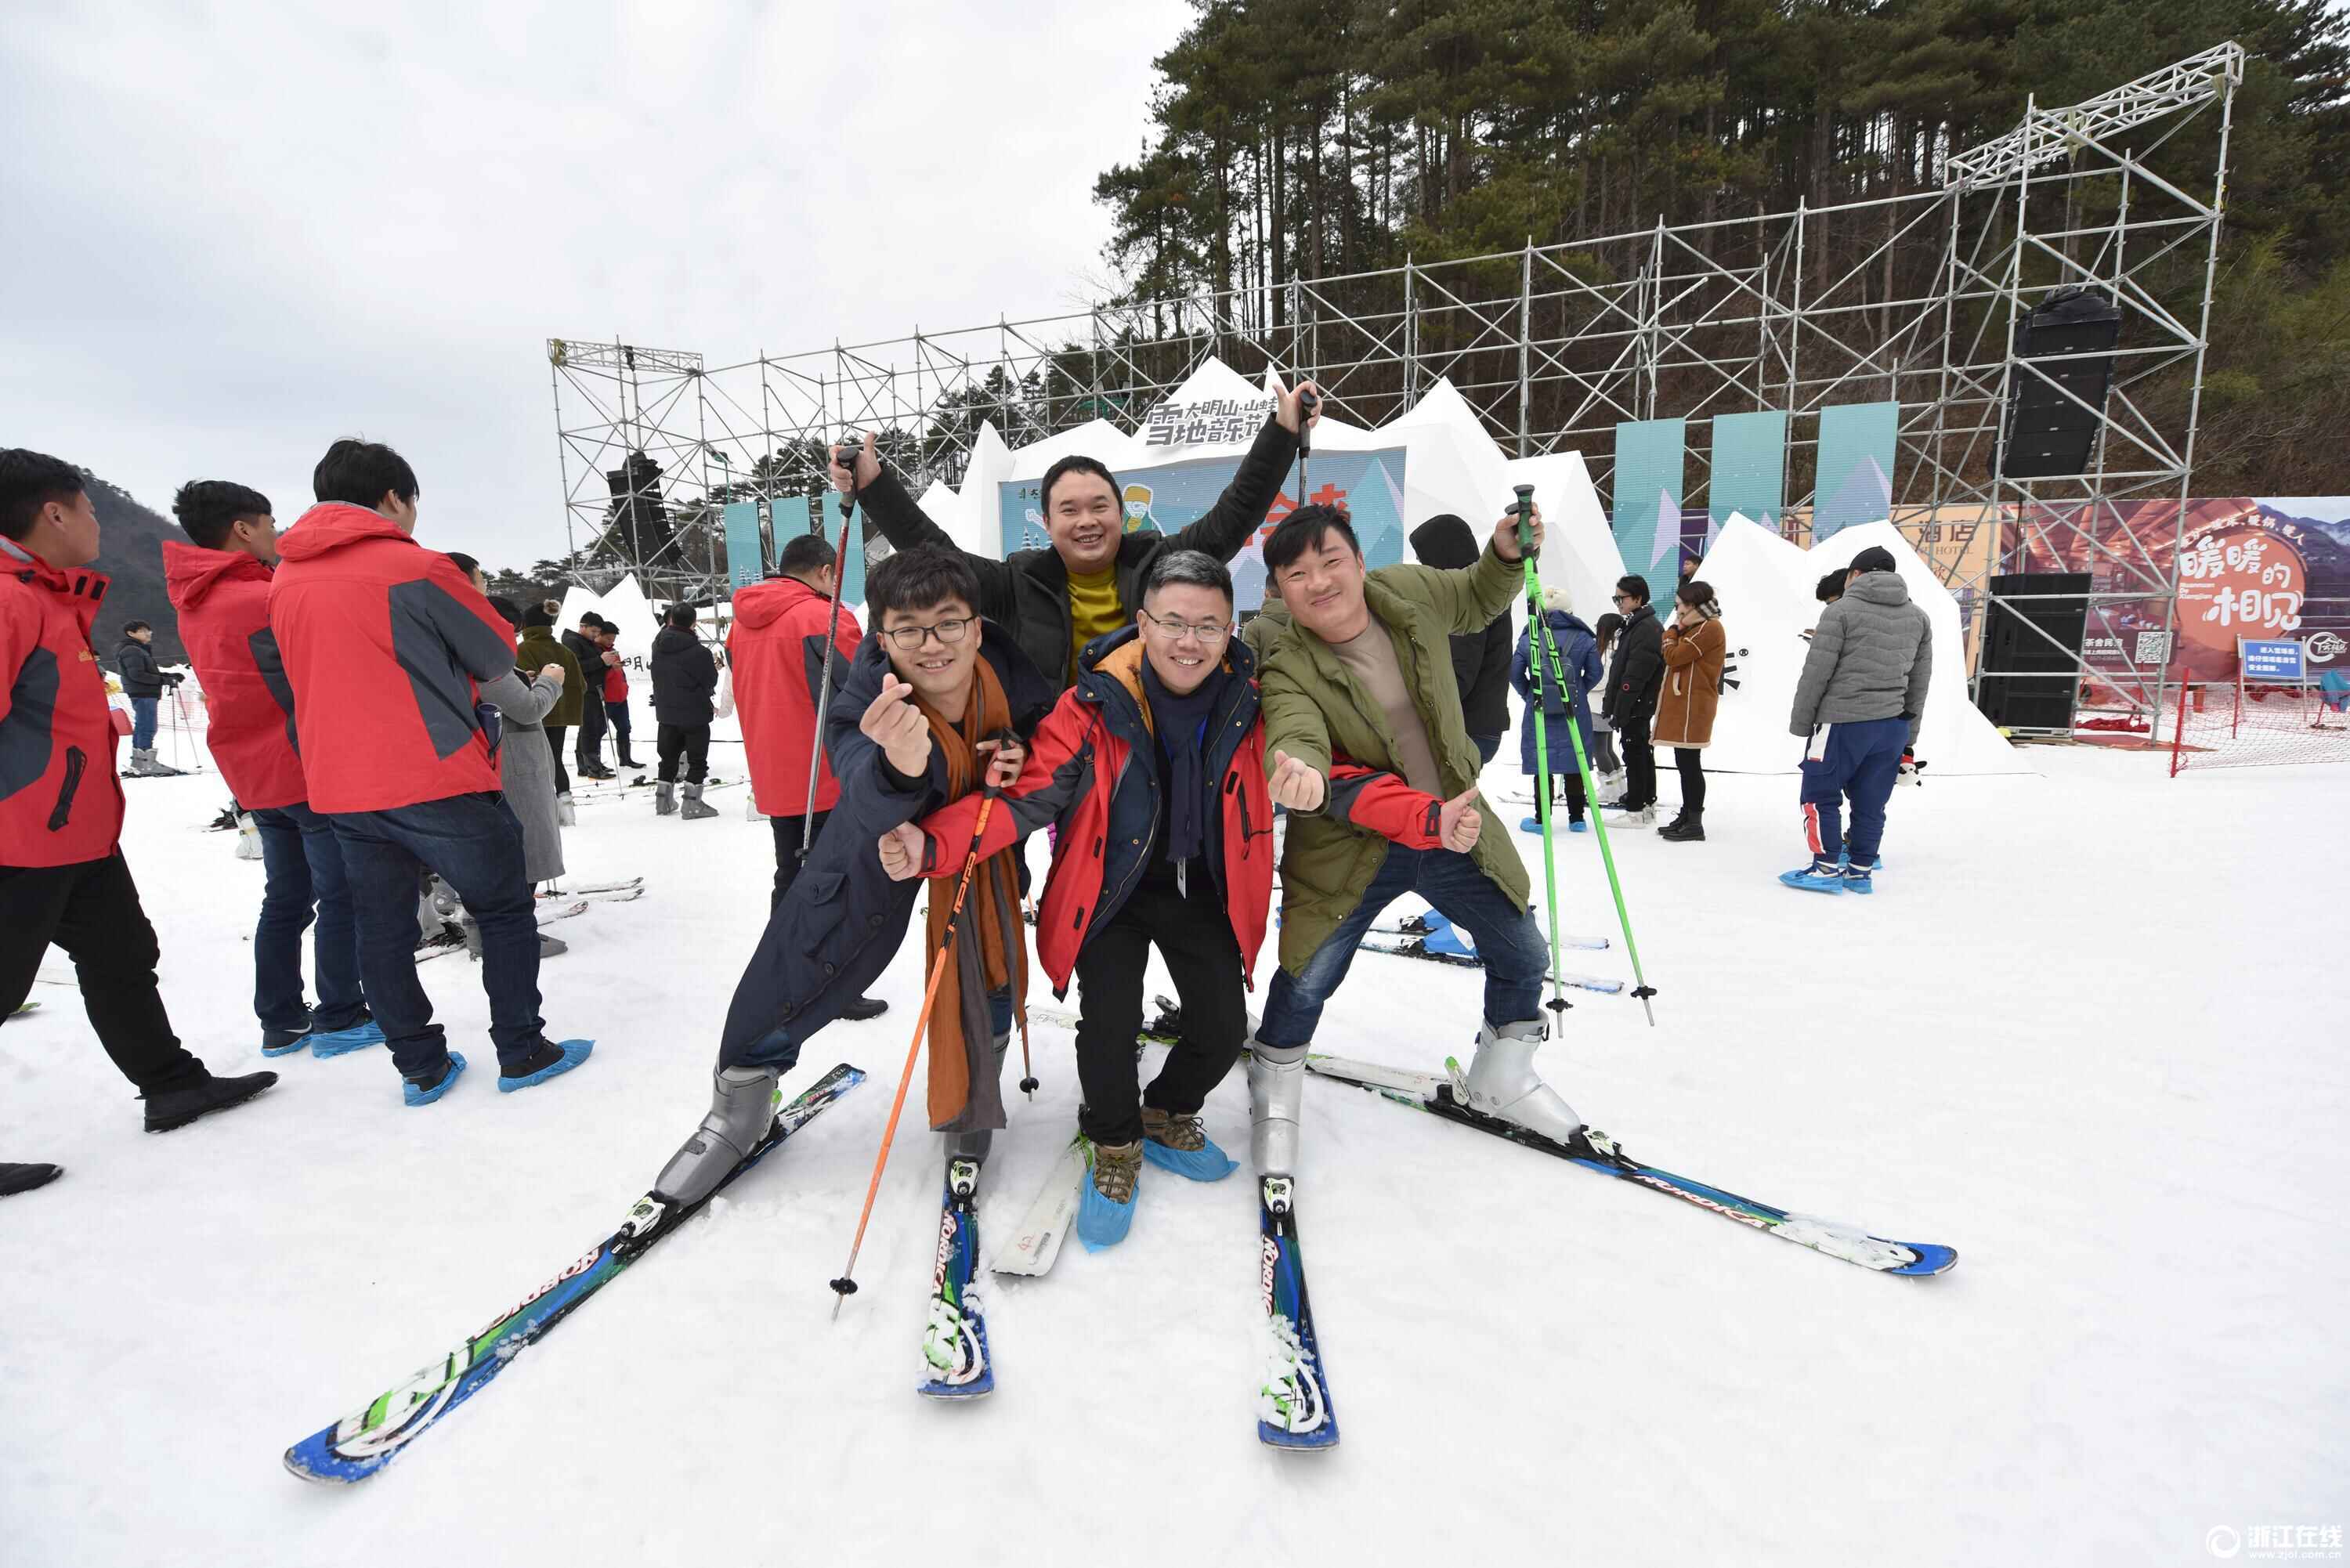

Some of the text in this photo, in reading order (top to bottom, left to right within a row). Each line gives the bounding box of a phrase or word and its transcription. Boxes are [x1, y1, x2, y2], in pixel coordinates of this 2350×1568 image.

[1146, 403, 1263, 446] 雪地音乐节
[2179, 535, 2291, 588] 暖暖的
[2202, 586, 2305, 630] 相见
[1528, 615, 1542, 694] elan
[1542, 626, 1571, 702] elan
[1632, 1175, 1766, 1229] NORDICA
